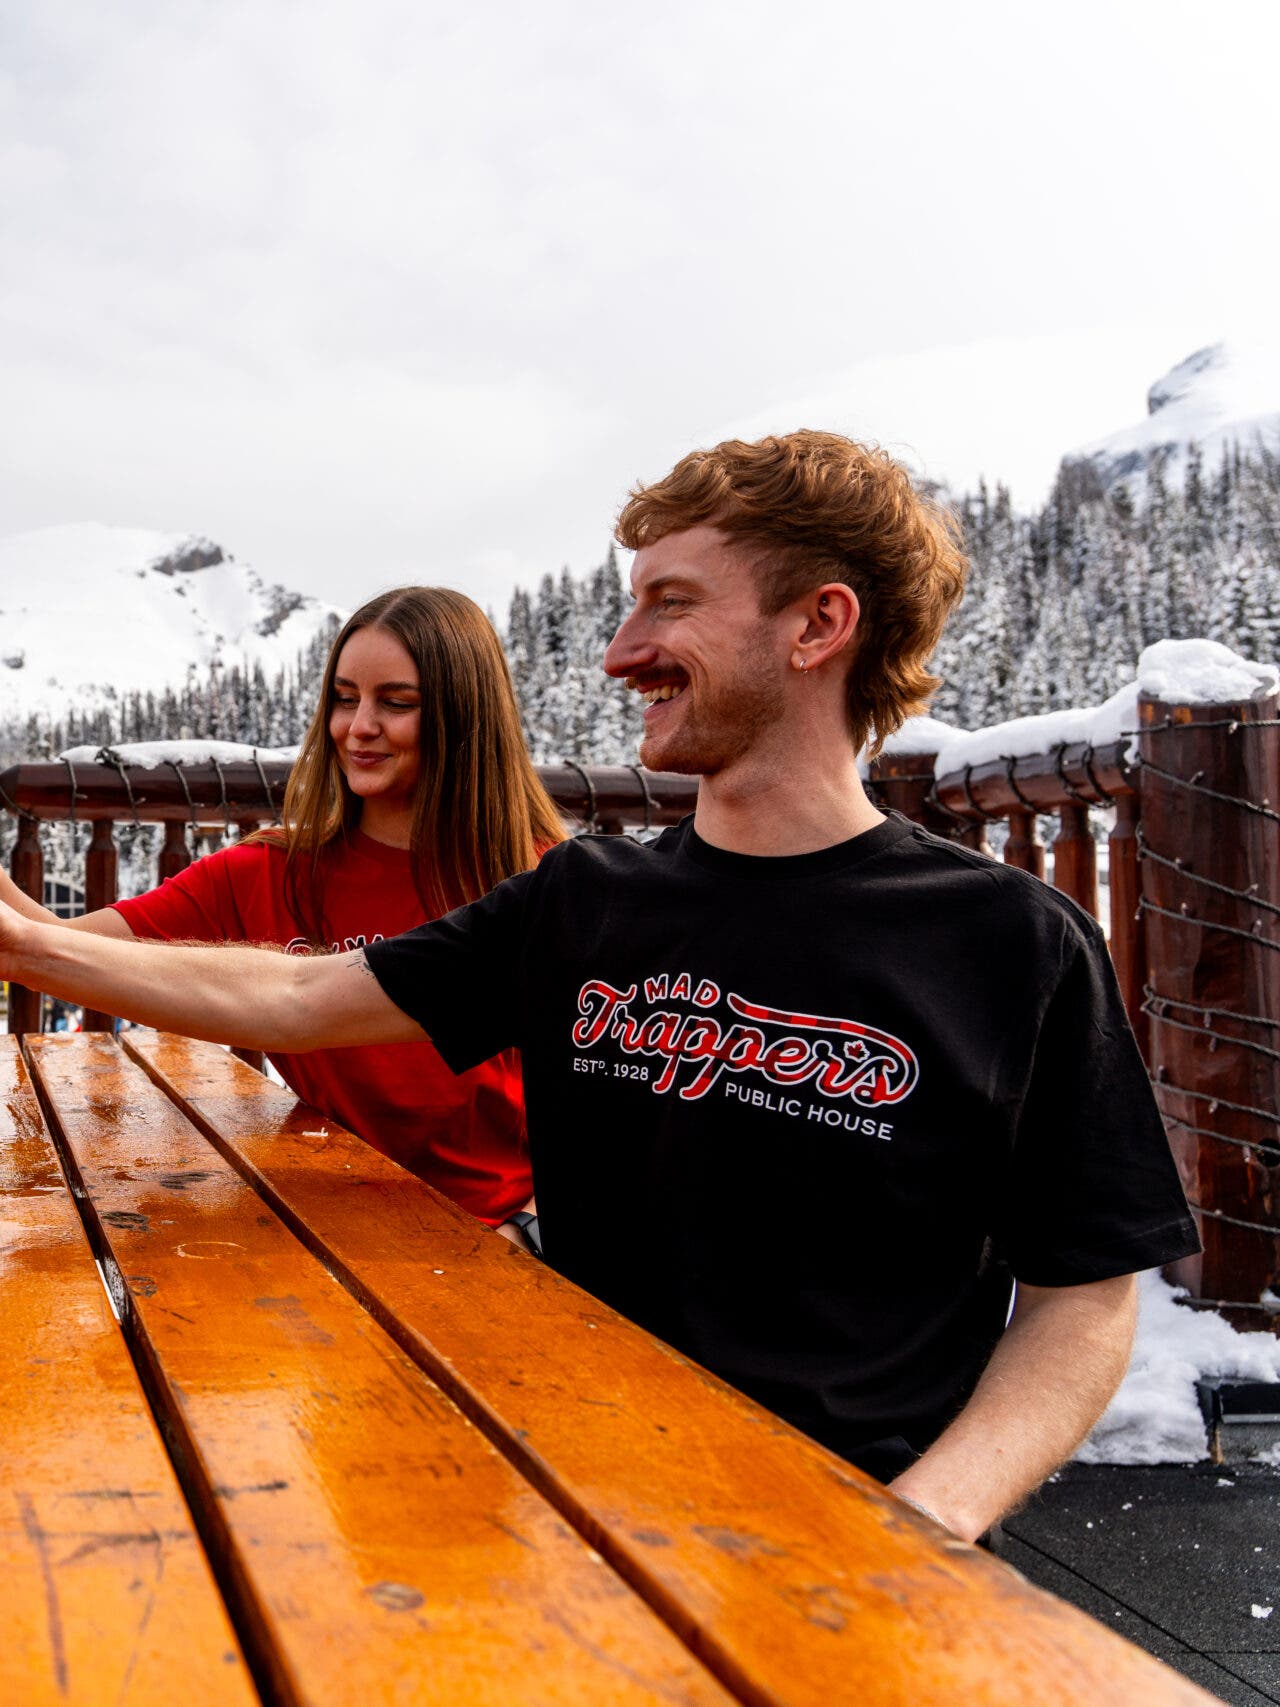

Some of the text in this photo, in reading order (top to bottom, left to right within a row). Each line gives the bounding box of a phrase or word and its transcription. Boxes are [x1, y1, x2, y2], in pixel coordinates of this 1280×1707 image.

[644, 973, 720, 1008] MAD
[572, 979, 920, 1108] Trapper's
[612, 1063, 649, 1082] 1928
[725, 1082, 894, 1141] PUBLIC HOUSE
